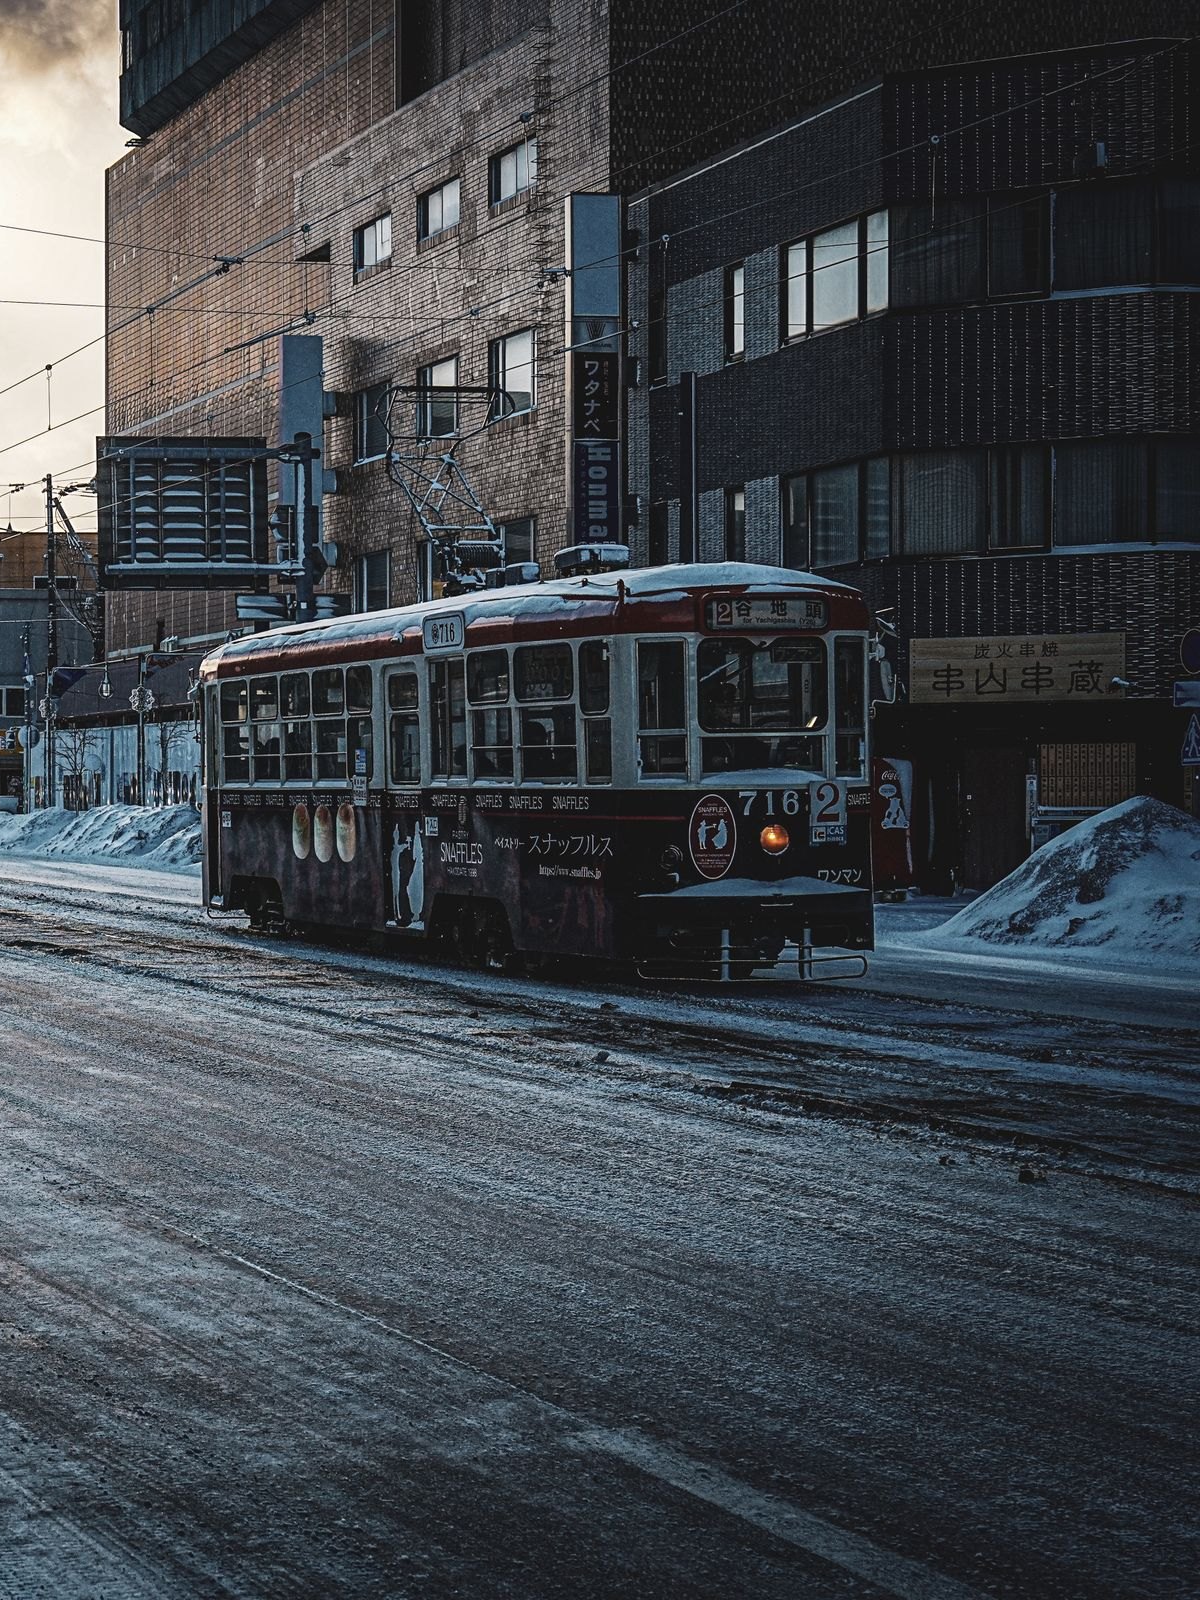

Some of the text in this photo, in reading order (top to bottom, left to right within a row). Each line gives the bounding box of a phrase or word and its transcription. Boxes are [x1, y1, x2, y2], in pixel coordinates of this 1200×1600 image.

[584, 361, 601, 433] ワタナベ
[587, 447, 611, 537] Honma
[718, 599, 823, 622] 2 谷地頭
[439, 622, 455, 643] 716
[974, 641, 1059, 660] 炭火串焼
[932, 659, 1105, 697] 串山串蔵
[509, 795, 543, 809] SNAFFLES
[552, 795, 589, 810] SNAFFLES
[738, 790, 799, 816] 716
[816, 782, 840, 823] 2
[827, 826, 844, 835] ICAS
[440, 842, 483, 864] SNAFFLE'S
[528, 833, 614, 857] スナッフルス
[818, 869, 862, 883] ワンマン
